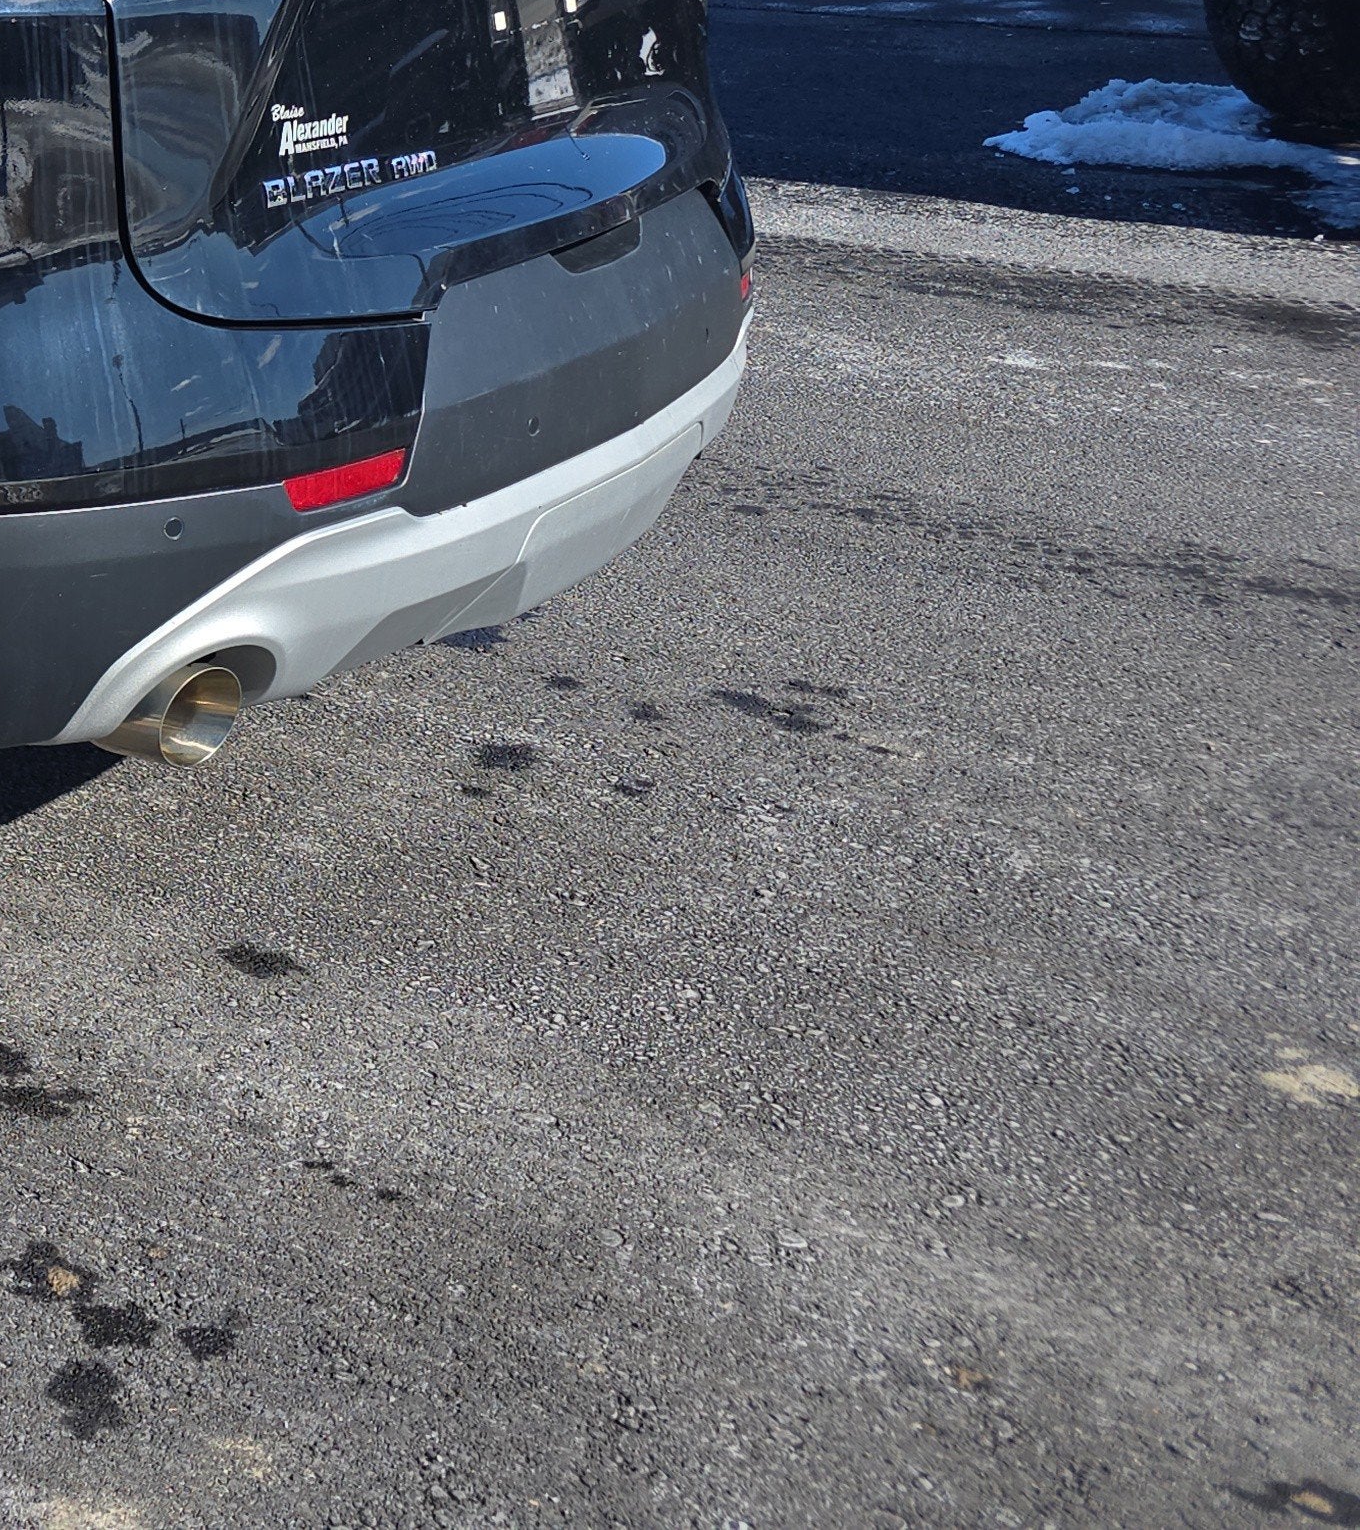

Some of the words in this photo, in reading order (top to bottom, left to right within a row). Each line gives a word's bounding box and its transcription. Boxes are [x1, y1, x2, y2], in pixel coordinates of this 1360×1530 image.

[271, 104, 305, 122] Blaise
[279, 113, 349, 156] Alexander
[262, 158, 382, 208] BLAZER
[391, 150, 438, 180] AWD
